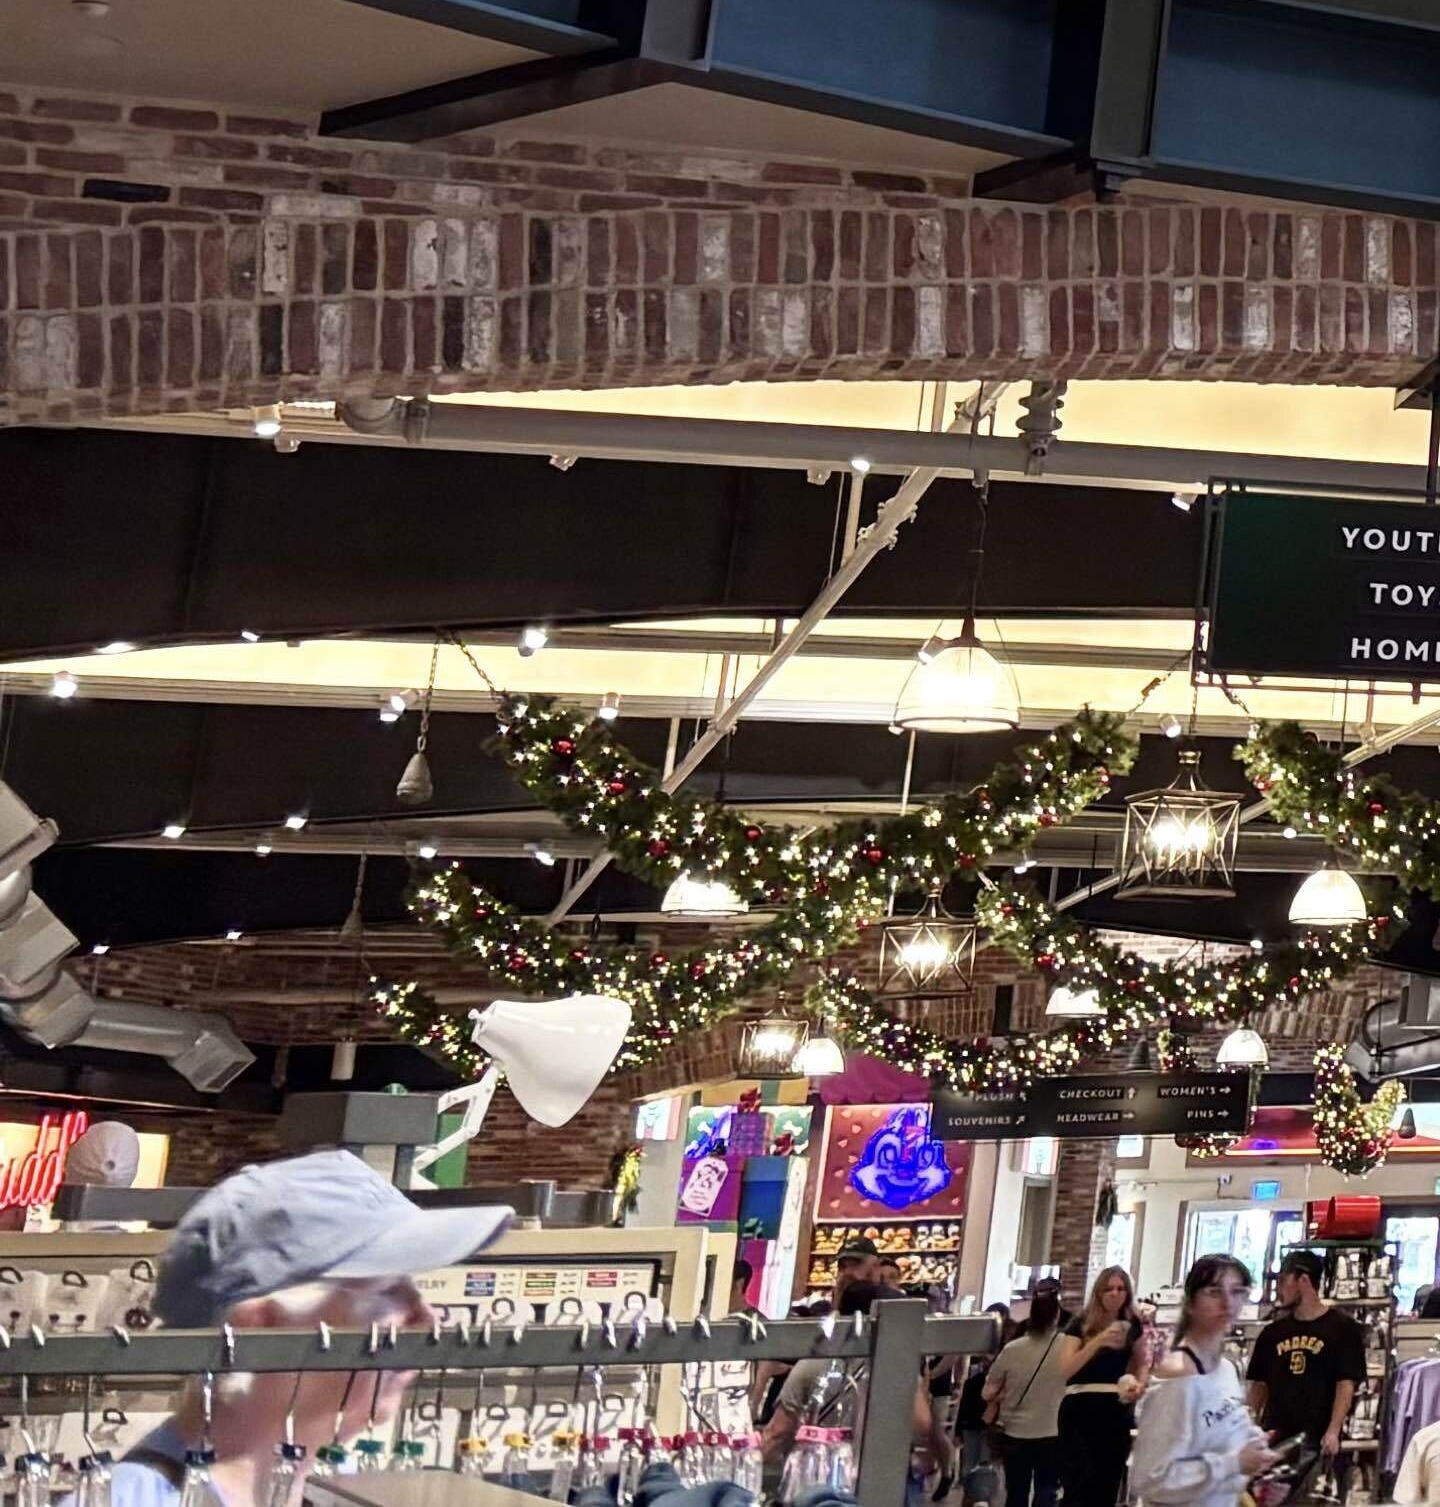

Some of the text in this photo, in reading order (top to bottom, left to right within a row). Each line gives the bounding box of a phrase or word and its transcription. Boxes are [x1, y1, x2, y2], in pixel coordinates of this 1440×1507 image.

[1059, 1088, 1123, 1100] CHECKOUT
[1159, 1085, 1217, 1097] WOMEN'S
[1056, 1111, 1120, 1123] HEADWEAR
[1186, 1109, 1214, 1119] PINS
[948, 1115, 1012, 1126] SOUVENIRS
[1276, 1335, 1325, 1356] PADRES
